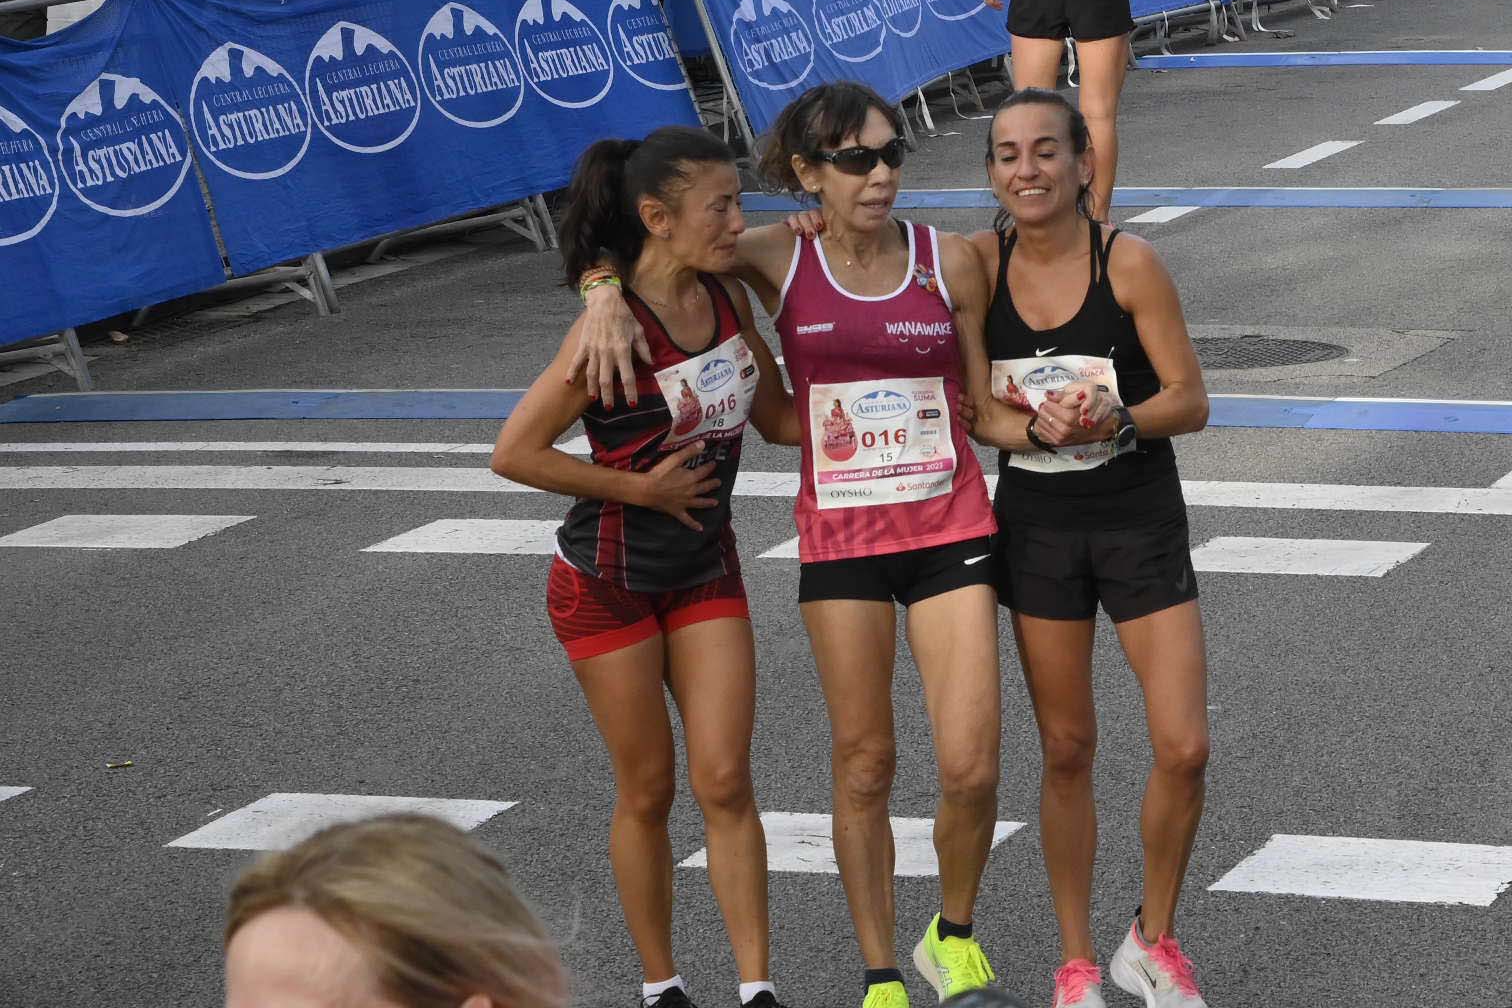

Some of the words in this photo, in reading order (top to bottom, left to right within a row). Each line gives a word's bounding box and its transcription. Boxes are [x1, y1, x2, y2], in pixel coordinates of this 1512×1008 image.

[821, 5, 881, 45] ASTURIAN
[524, 37, 609, 83] ASTURIANA
[428, 53, 520, 102] ASTURIANA
[316, 77, 415, 128] ASTURIANA
[202, 100, 306, 153] ASTURIANA
[886, 320, 952, 337] WANAWAKE
[705, 394, 737, 419] 016
[713, 418, 724, 428] 18
[861, 428, 908, 448] 016
[879, 452, 893, 463] 15
[832, 469, 870, 481] CARRERA
[872, 468, 882, 479] DE
[884, 466, 895, 477] LA
[896, 464, 923, 476] MUJER
[830, 487, 872, 499] OYSHO
